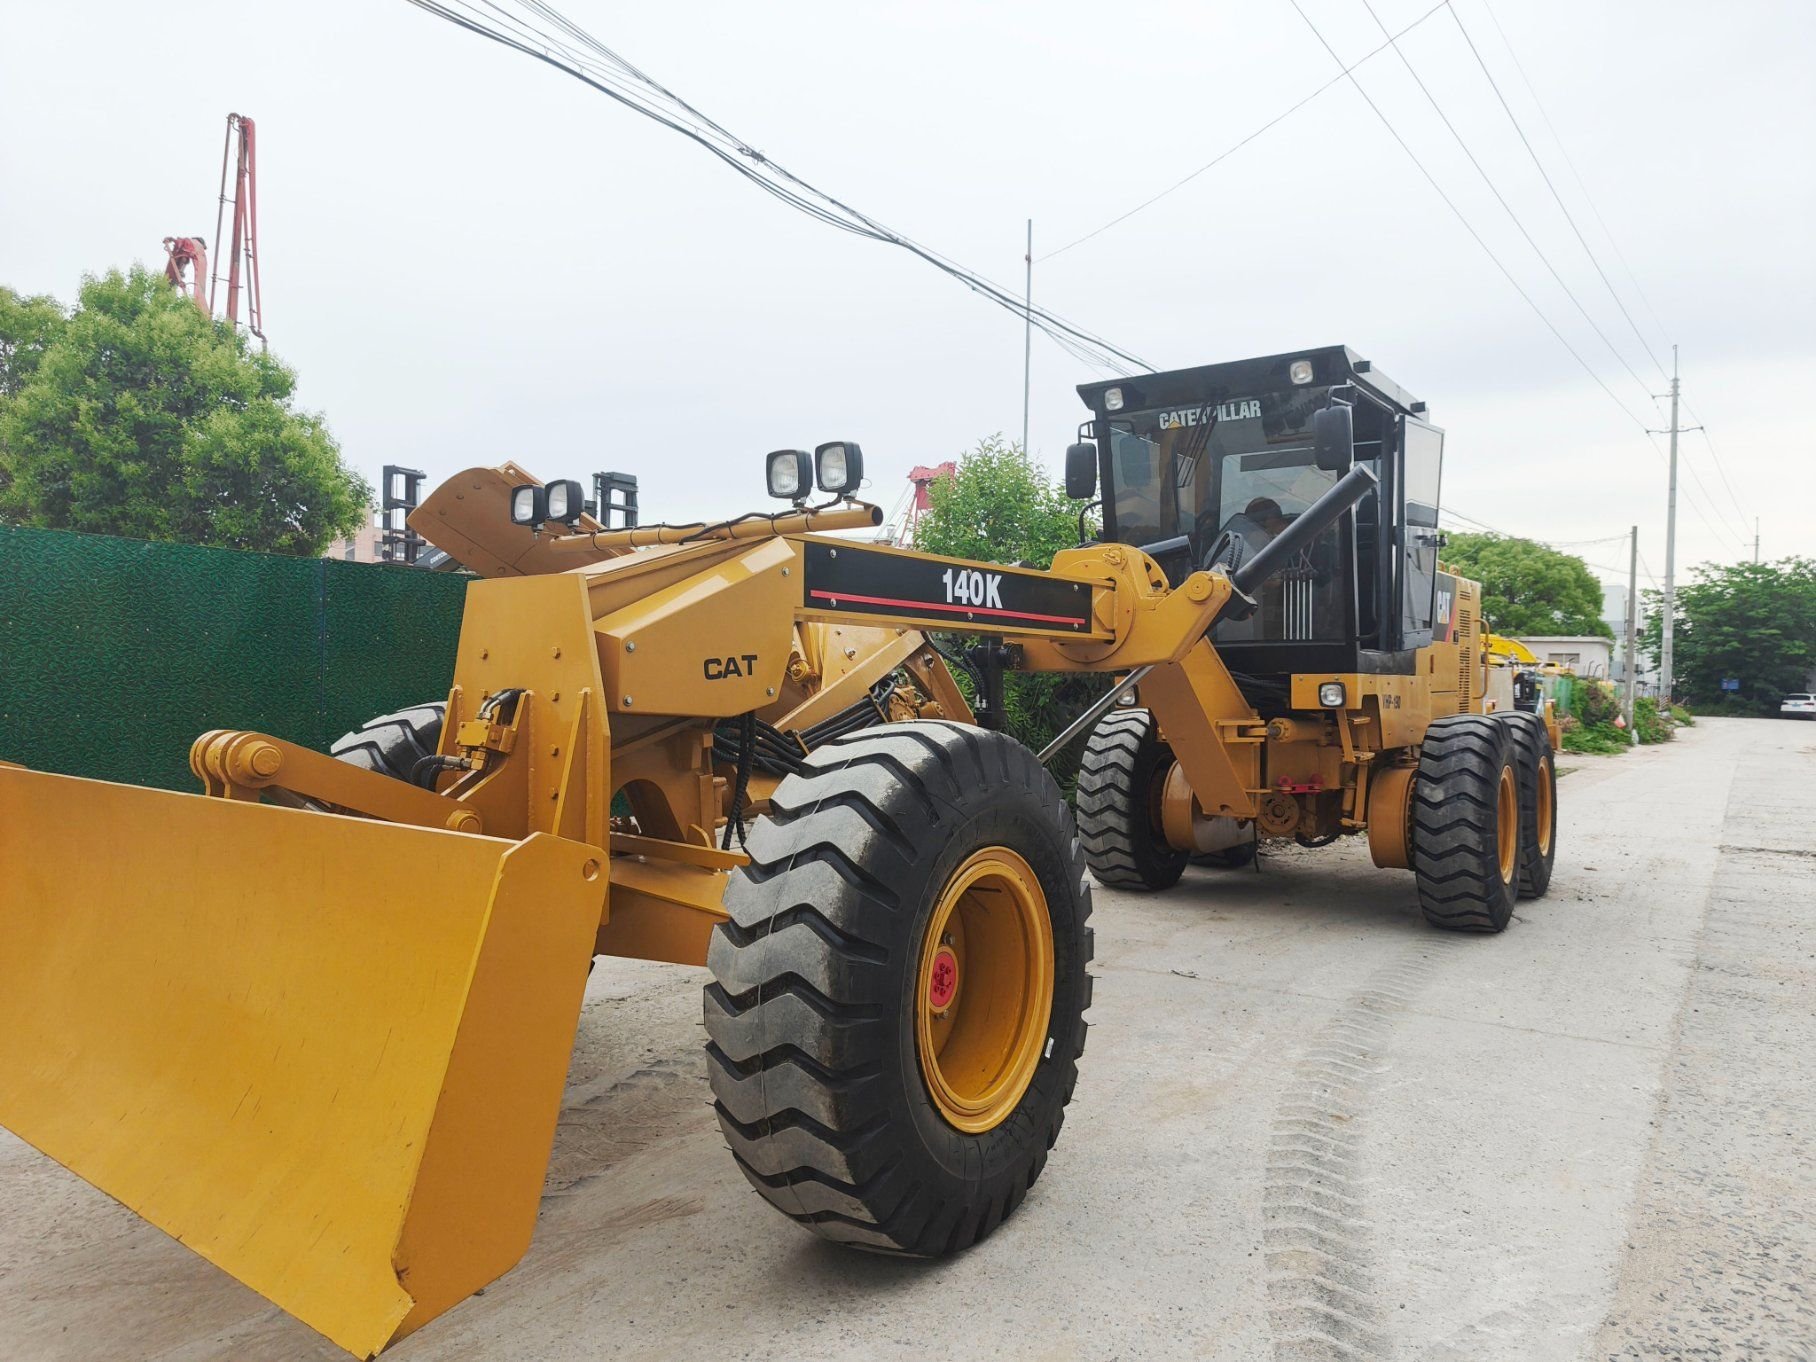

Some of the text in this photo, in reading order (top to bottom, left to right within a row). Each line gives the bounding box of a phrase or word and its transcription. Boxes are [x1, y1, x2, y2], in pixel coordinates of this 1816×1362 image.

[942, 568, 1003, 609] 140K
[1437, 590, 1451, 624] CAT
[703, 655, 757, 680] CAT
